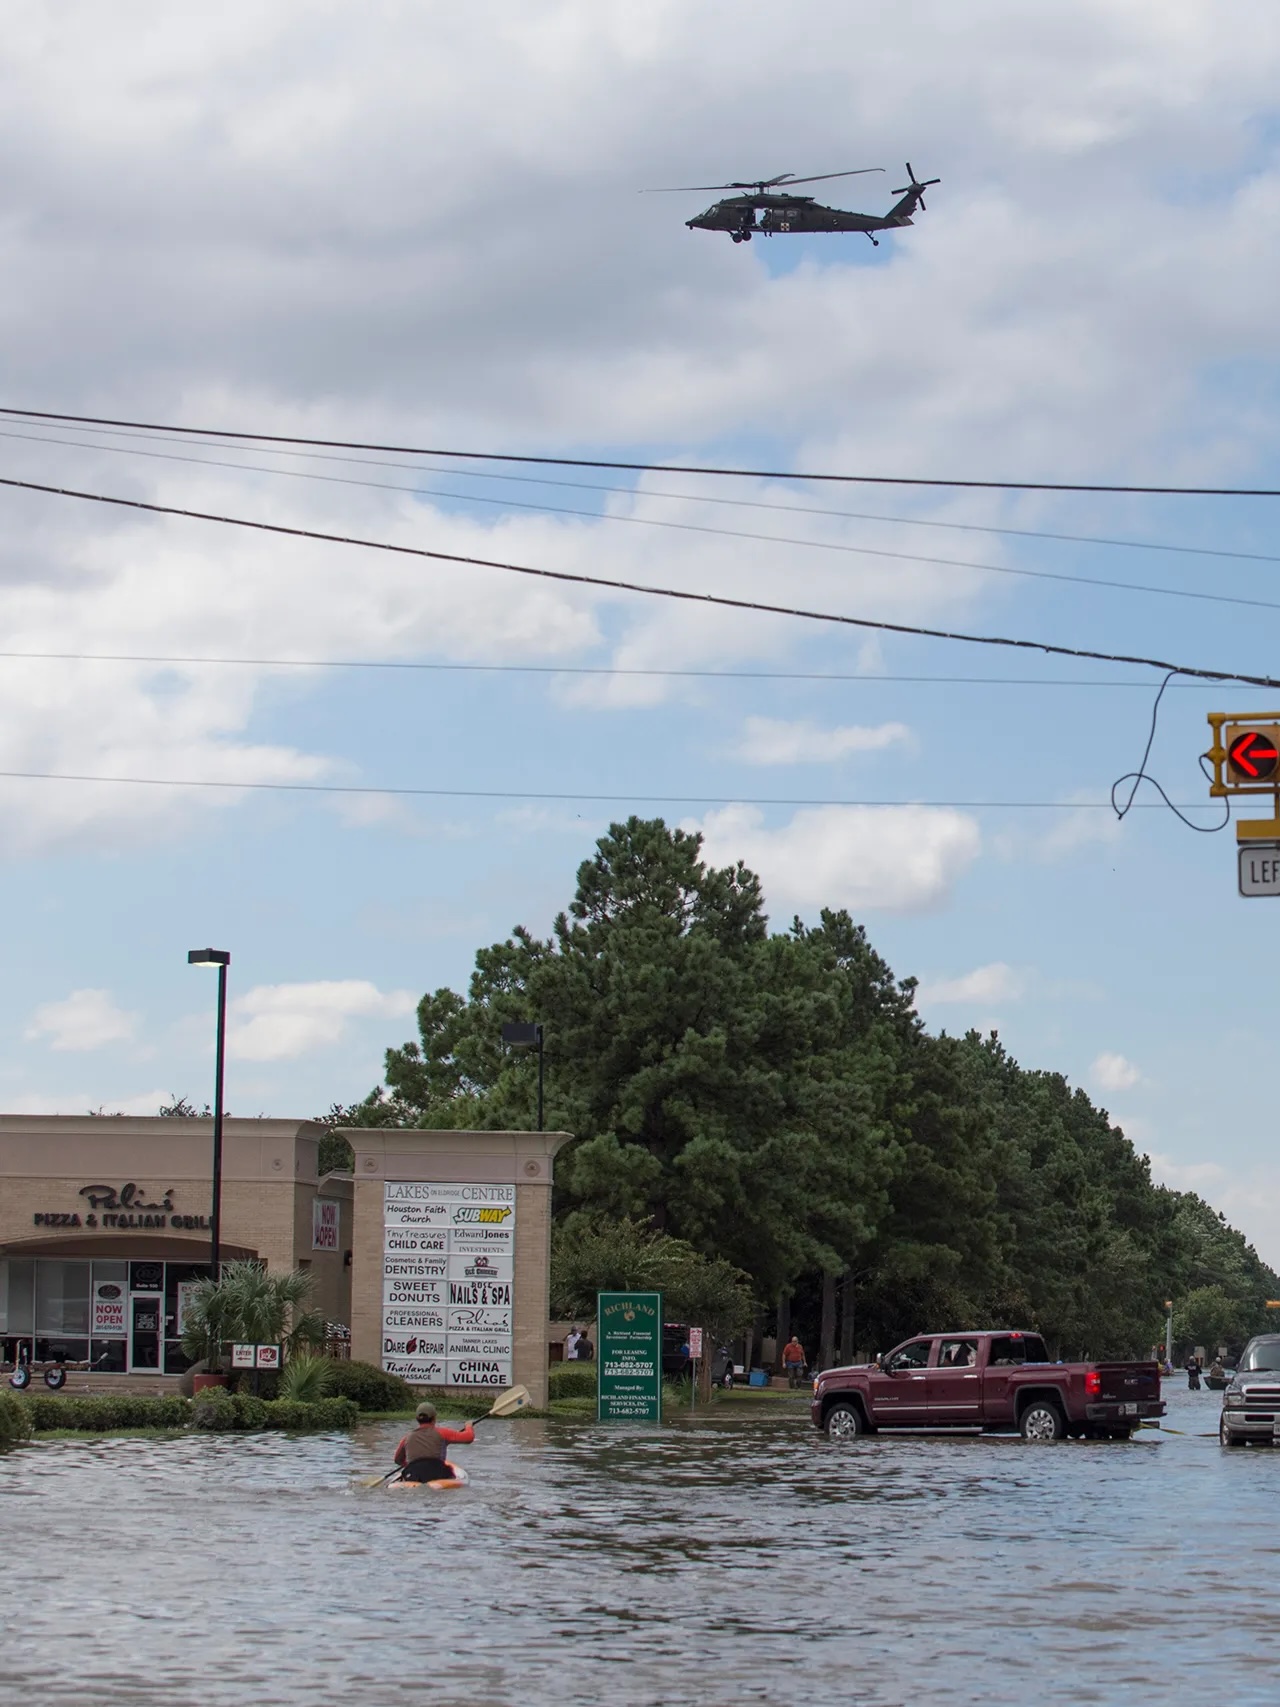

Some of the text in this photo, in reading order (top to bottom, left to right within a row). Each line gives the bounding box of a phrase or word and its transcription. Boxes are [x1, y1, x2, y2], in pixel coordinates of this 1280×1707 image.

[387, 1185, 429, 1199] LAKES
[462, 1187, 513, 1201] CENTRE
[322, 1204, 336, 1225] NOW
[387, 1205, 446, 1214] Houston Faith
[34, 1213, 81, 1227] PIZZA
[86, 1214, 97, 1227] &
[103, 1214, 165, 1228] ITALIAN
[401, 1214, 431, 1223] Church
[455, 1207, 510, 1224] SUBWAY
[320, 1226, 337, 1247] OPEN
[387, 1230, 446, 1239] Tiny Treasures
[389, 1240, 444, 1250] CHILD CARE
[385, 1256, 416, 1264] Cosmetic
[425, 1257, 446, 1265] Family
[385, 1265, 446, 1275] DENTISTRY
[393, 1282, 437, 1291] SWEET
[389, 1293, 440, 1302] DONUTS
[450, 1283, 510, 1305] NAILS & SPA
[96, 1305, 122, 1313] NOW
[604, 1302, 655, 1316] RICHLAND
[96, 1315, 123, 1324] OPEN
[385, 1317, 443, 1326] CLEANERS
[419, 1339, 444, 1354] REPAIR
[450, 1345, 510, 1354] ANIMAL CLINIC
[459, 1362, 499, 1372] CHINA
[453, 1373, 507, 1384] VILLAGE
